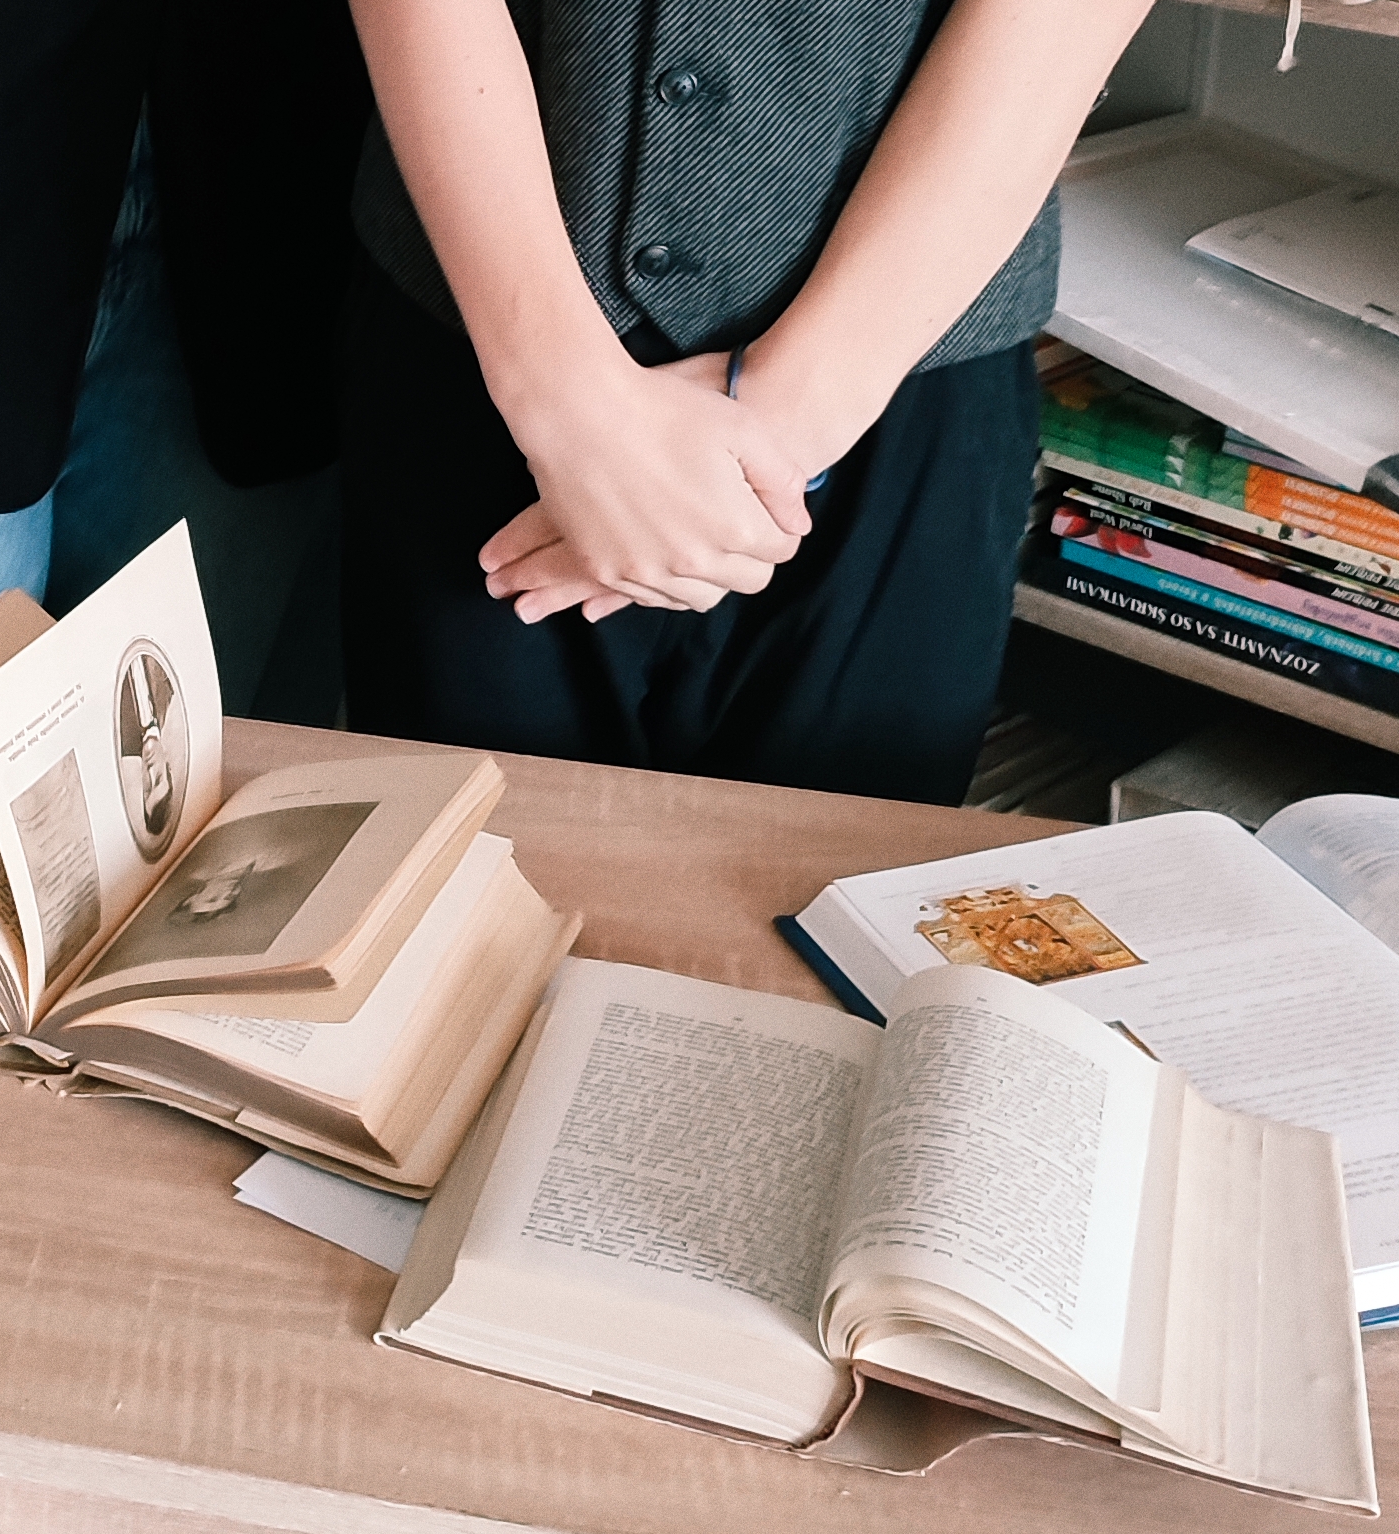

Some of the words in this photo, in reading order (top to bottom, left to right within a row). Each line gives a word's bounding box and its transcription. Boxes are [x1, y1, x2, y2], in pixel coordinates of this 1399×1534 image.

[1089, 507, 1117, 528] West
[1118, 516, 1153, 540] David
[1066, 574, 1168, 625] ŠKRIATKAMI
[1170, 612, 1194, 632] SO
[1194, 619, 1218, 641] SA
[1220, 629, 1322, 676] ZOZNÁMTE
